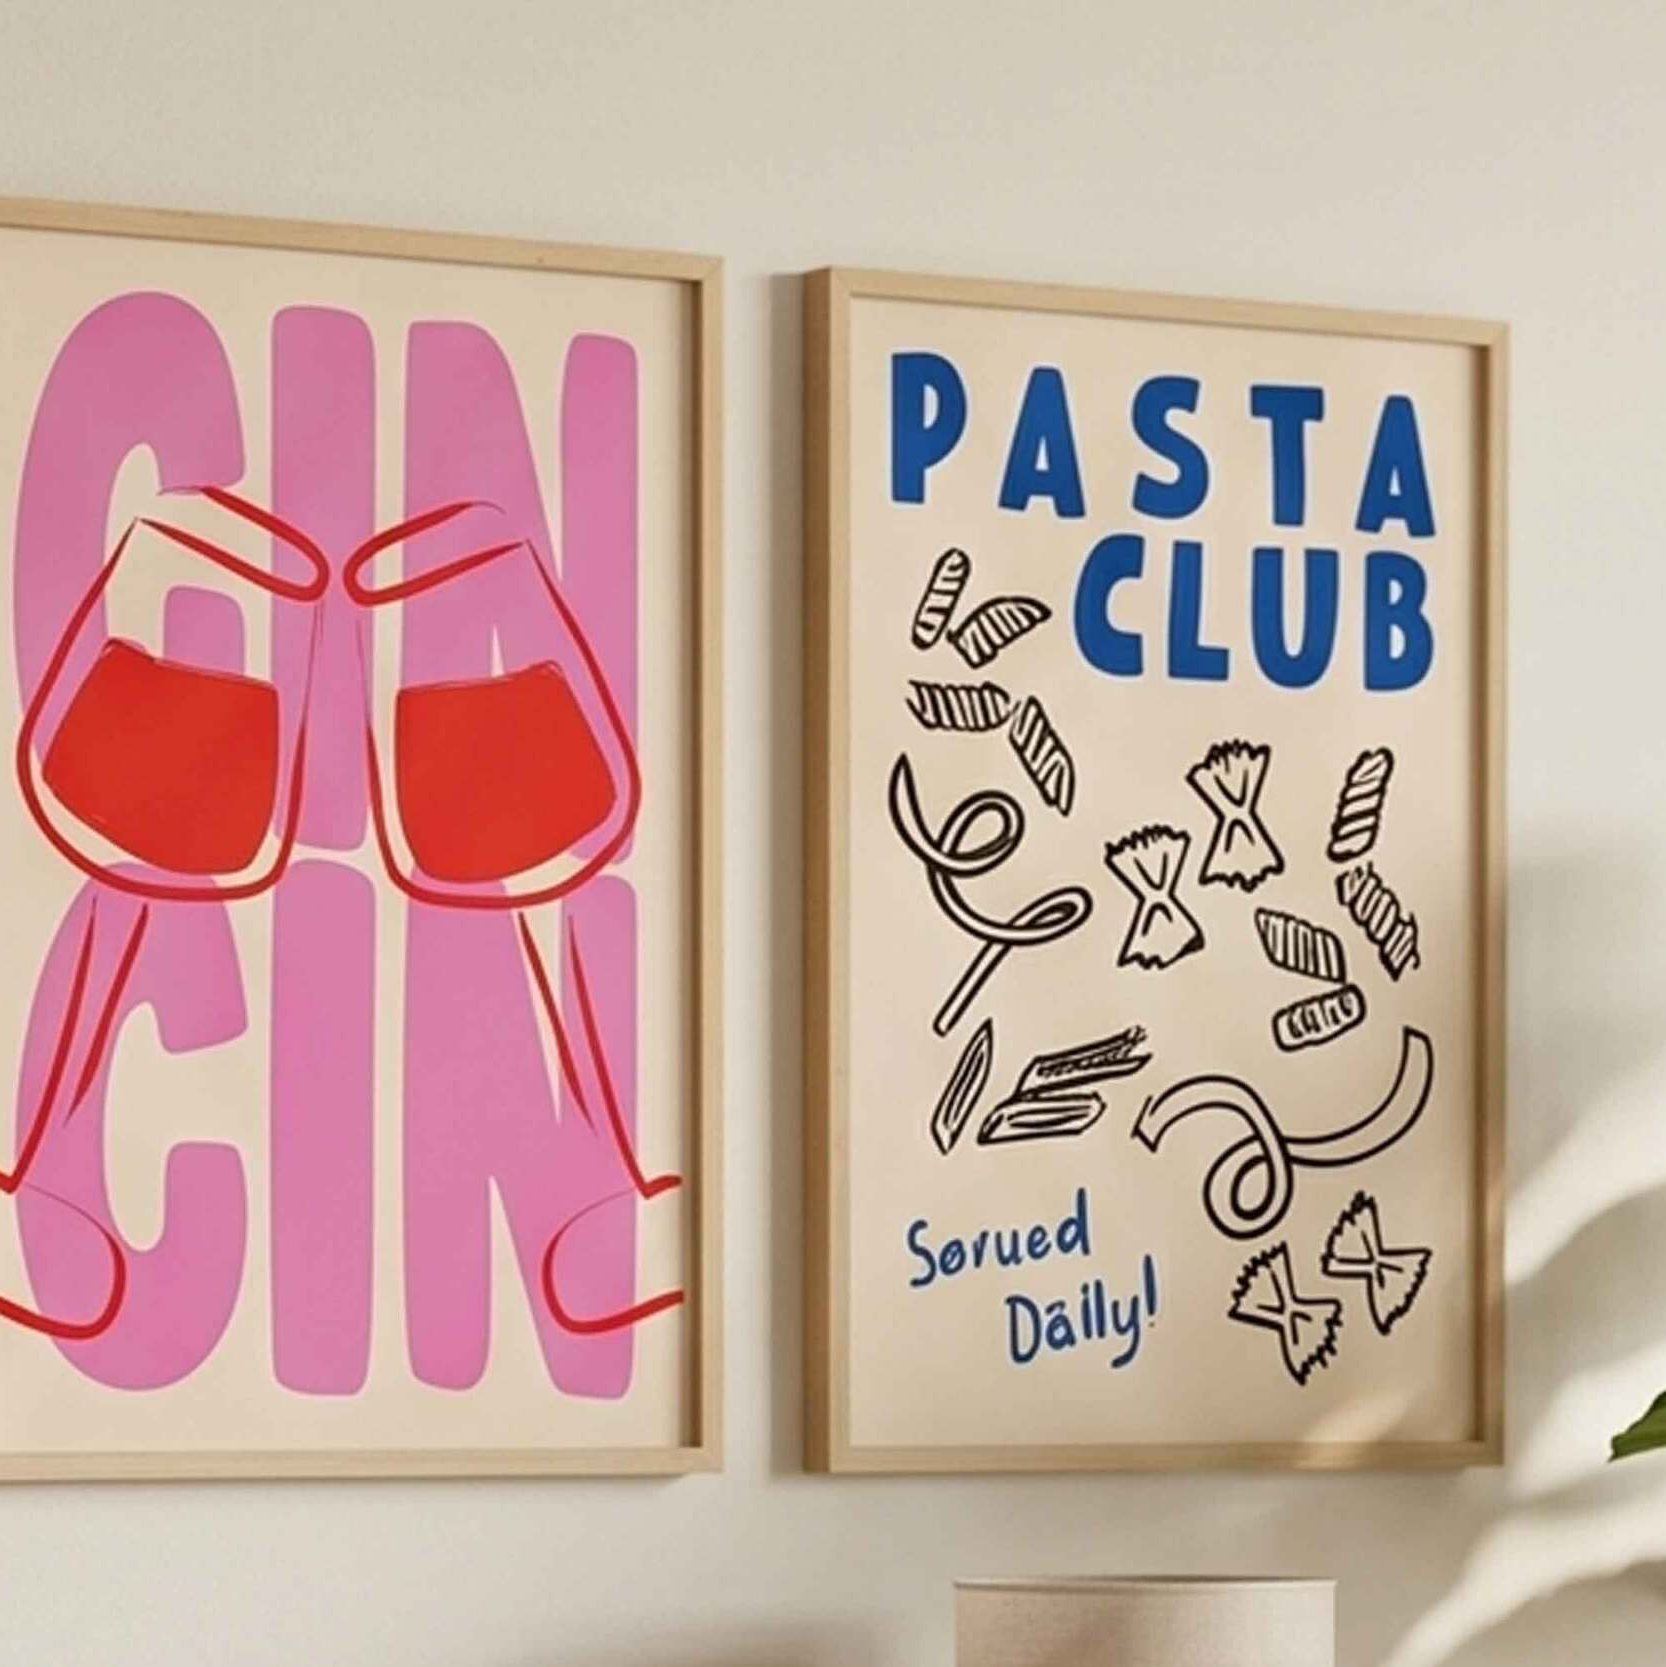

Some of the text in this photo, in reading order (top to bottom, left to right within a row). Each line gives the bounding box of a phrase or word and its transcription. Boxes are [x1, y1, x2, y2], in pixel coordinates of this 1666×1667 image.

[890, 351, 1436, 538] PASTA
[1072, 533, 1435, 692] CLUB
[15, 858, 638, 1398] CIN
